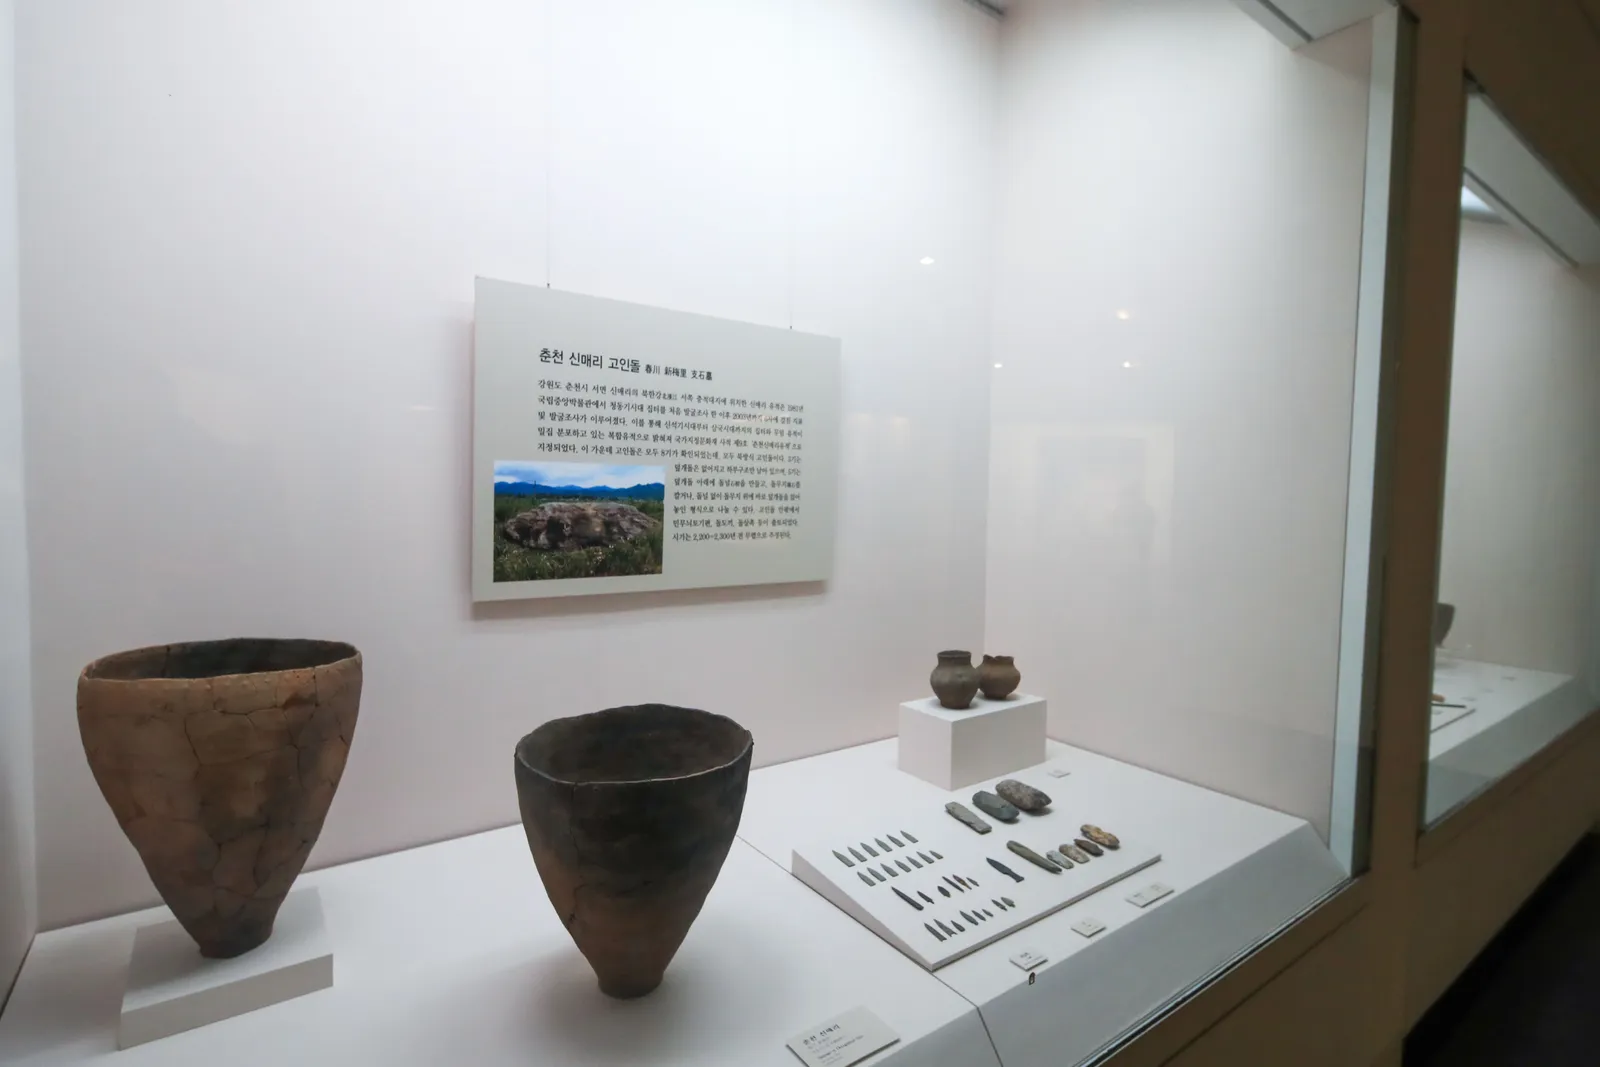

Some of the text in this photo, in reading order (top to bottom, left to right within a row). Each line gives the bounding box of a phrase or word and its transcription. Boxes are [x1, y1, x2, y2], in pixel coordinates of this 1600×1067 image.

[539, 348, 564, 364] 춘천
[569, 352, 603, 369] 신매리
[608, 358, 640, 373] 고인돌
[645, 364, 660, 375] 春川
[538, 380, 562, 389] 강원도
[566, 382, 588, 392] 춘천시
[592, 385, 606, 394] 서면
[610, 386, 638, 396] 신매리의
[538, 396, 606, 409] 국립중앙박물관에서
[610, 402, 644, 412] 청동기시대
[684, 409, 709, 419] 발굴조사
[549, 413, 587, 423] 발굴조사가
[557, 428, 587, 438] 분포하고
[608, 431, 649, 441] 복합유적으로
[538, 443, 578, 453] 지정되었다.
[581, 445, 588, 454] 이
[592, 445, 612, 454] 가운데
[616, 447, 643, 456] 고인돌은
[645, 448, 658, 457] 모두
